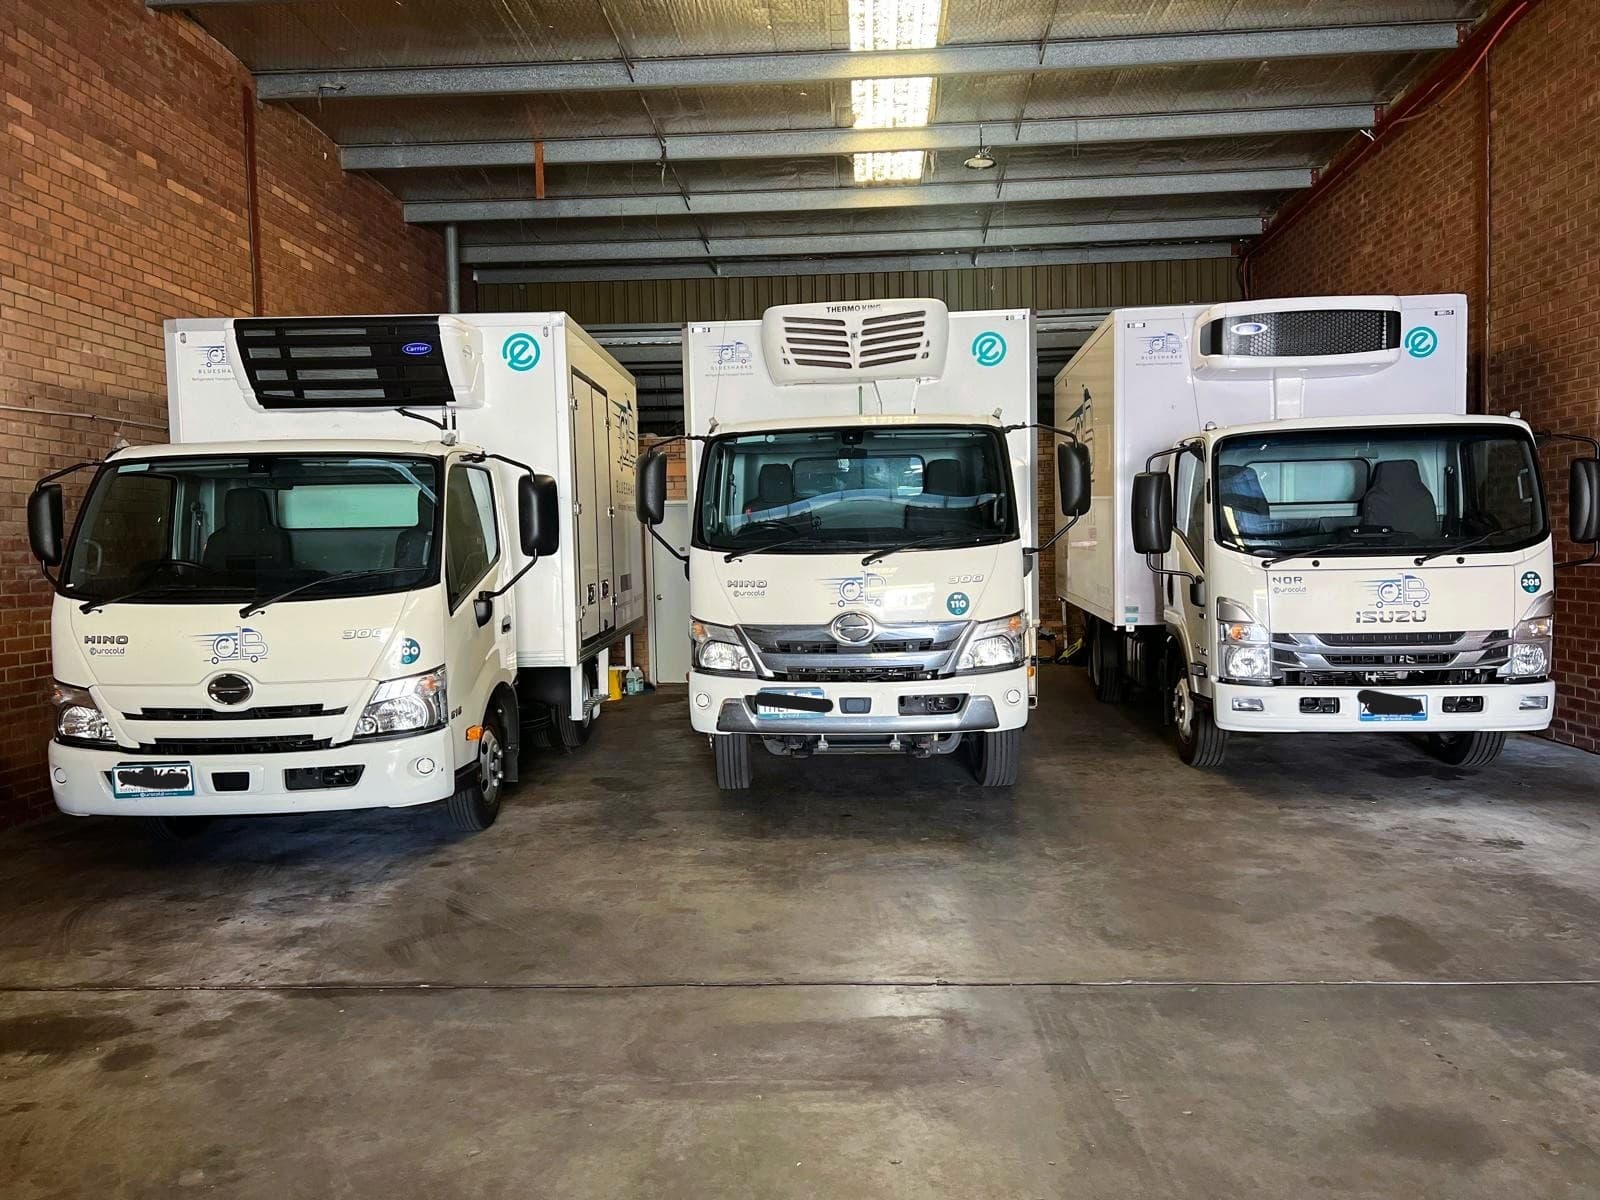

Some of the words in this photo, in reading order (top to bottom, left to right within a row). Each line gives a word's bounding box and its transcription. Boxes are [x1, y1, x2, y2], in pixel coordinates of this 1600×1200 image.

[826, 305, 860, 313] THERMO
[727, 580, 768, 588] HINO
[948, 575, 984, 585] 300
[950, 600, 967, 608] 110
[1356, 610, 1427, 624] ISUZU
[84, 635, 128, 645] HINO
